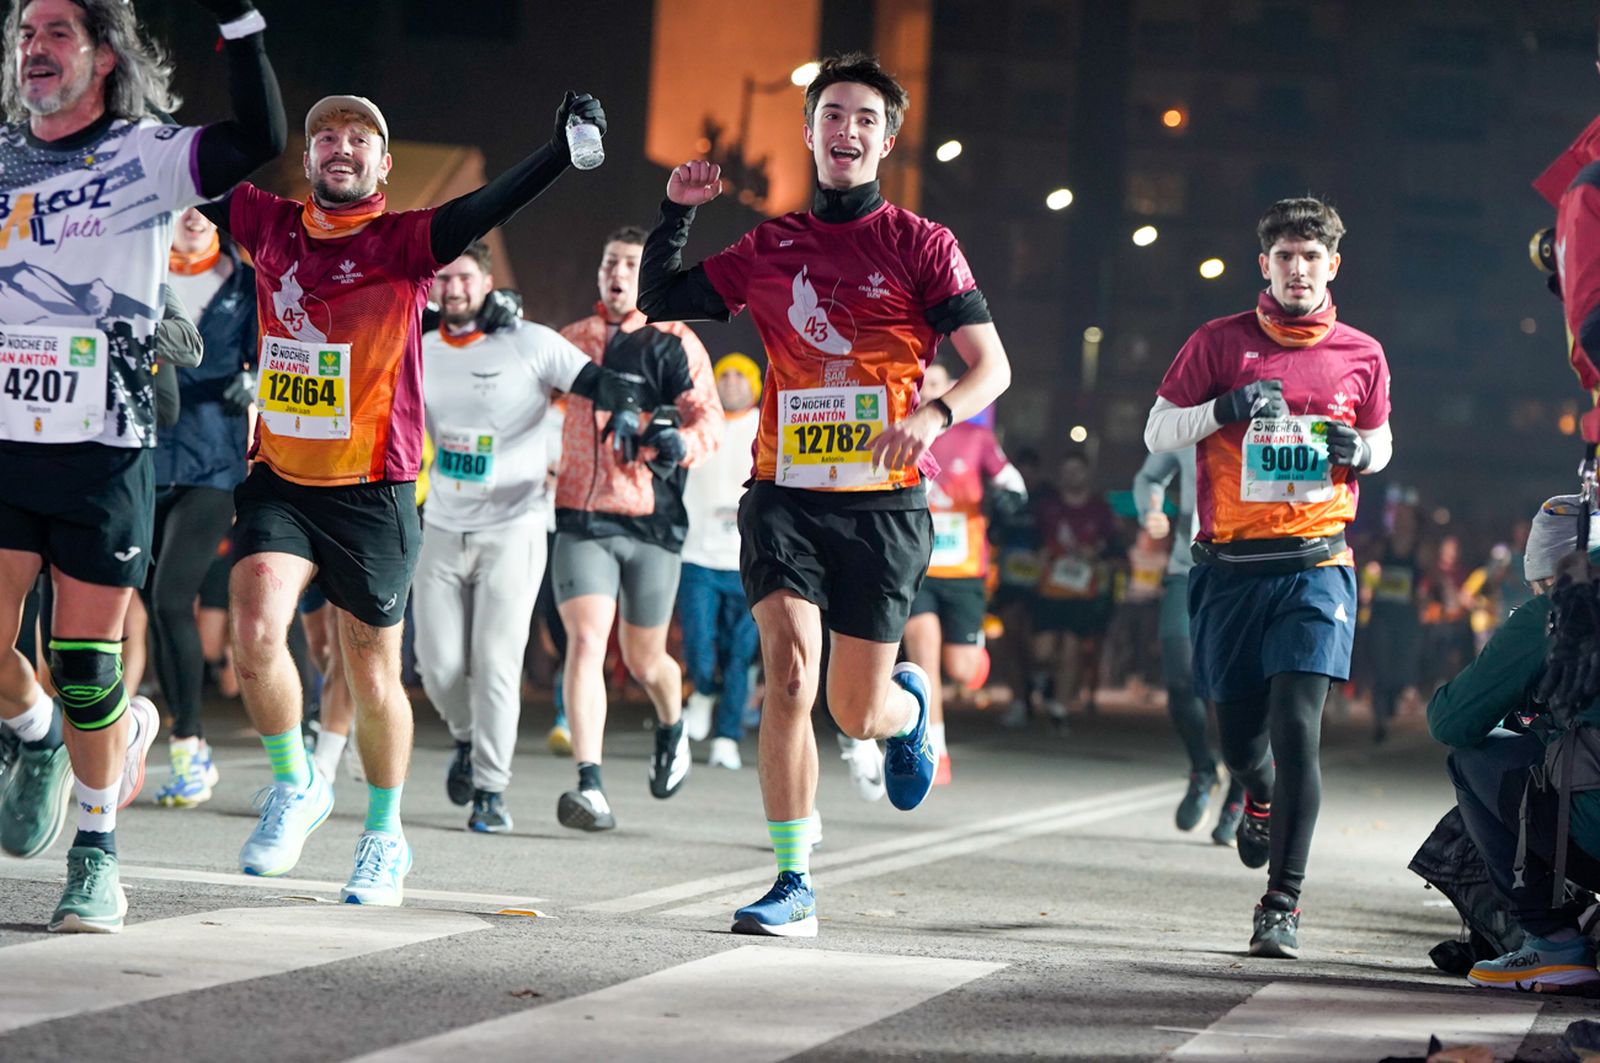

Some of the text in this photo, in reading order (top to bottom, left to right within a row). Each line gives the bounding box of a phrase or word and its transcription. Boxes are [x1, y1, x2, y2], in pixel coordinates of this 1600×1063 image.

[283, 307, 305, 332] 43
[804, 315, 828, 342] 43
[7, 338, 58, 352] NOCHE DE
[0, 351, 15, 364] AN
[18, 350, 58, 366] ANTÓN
[279, 349, 304, 361] NOCHE
[269, 359, 286, 371] SAN
[4, 367, 79, 404] 4207
[269, 373, 336, 407] 12664
[801, 399, 846, 410] NOCHE DE
[791, 412, 810, 423] SAN
[812, 409, 846, 422] ANTÓN
[1264, 423, 1291, 433] NOCHE
[794, 423, 872, 454] 12782
[1254, 434, 1272, 444] SAN
[1273, 432, 1304, 444] ANTÓN
[1262, 446, 1319, 472] 9007
